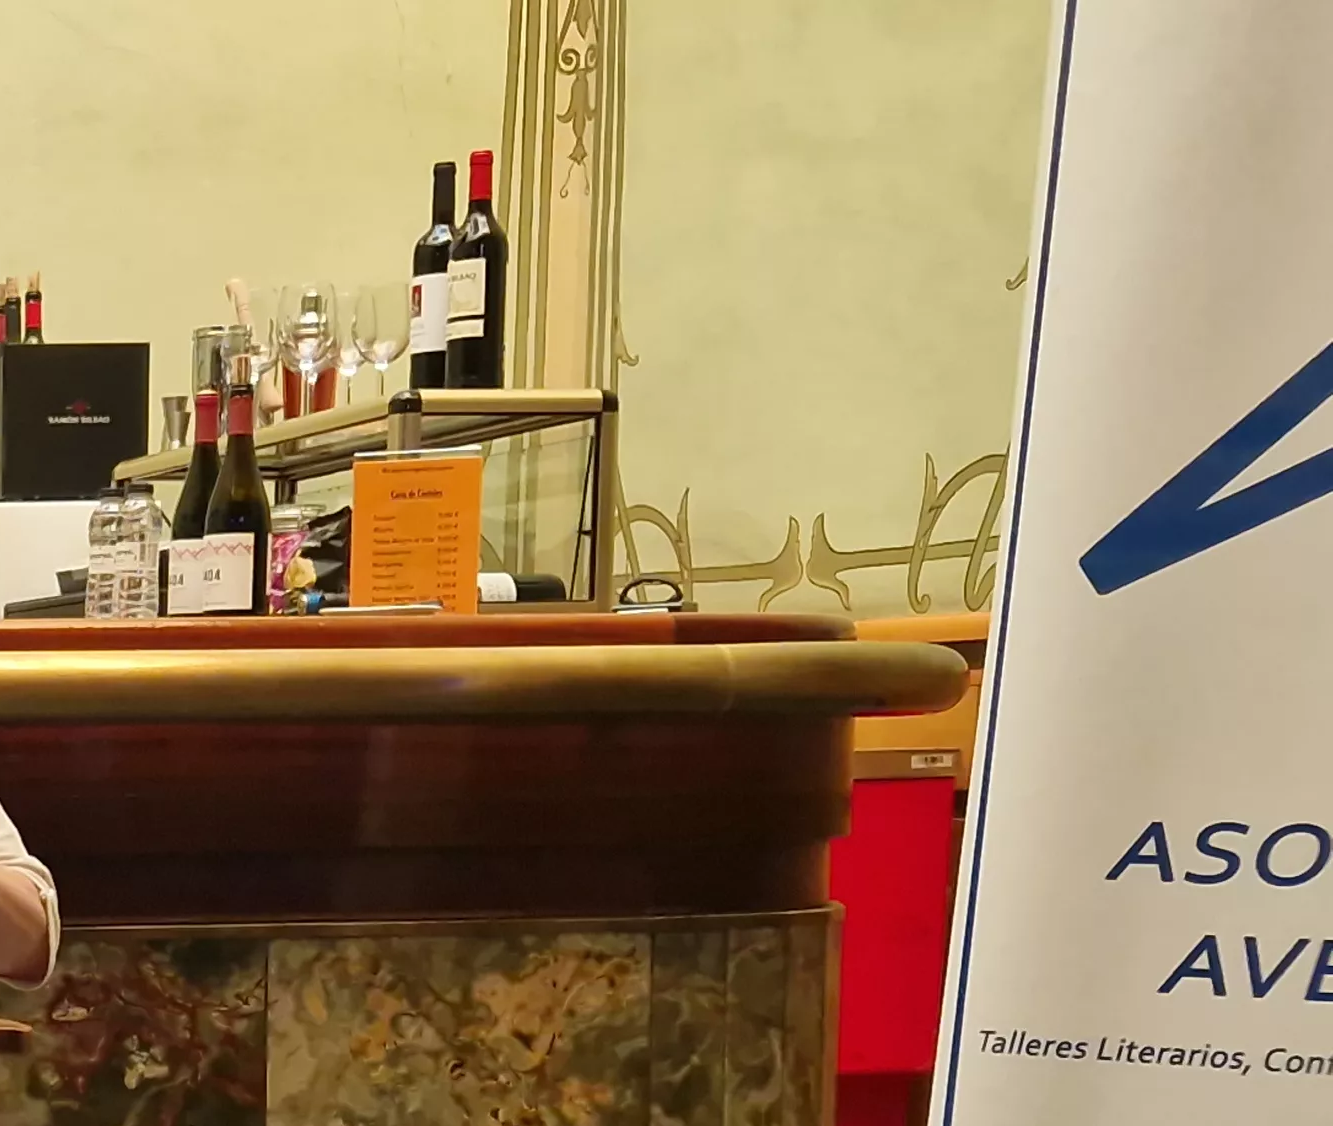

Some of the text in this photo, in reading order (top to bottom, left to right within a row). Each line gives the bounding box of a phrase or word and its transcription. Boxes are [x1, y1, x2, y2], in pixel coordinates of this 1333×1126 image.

[1105, 821, 1333, 887] ASO
[1157, 935, 1333, 1002] AVE
[979, 1030, 1088, 1060] Talleres
[1096, 1037, 1252, 1076] Literarios,
